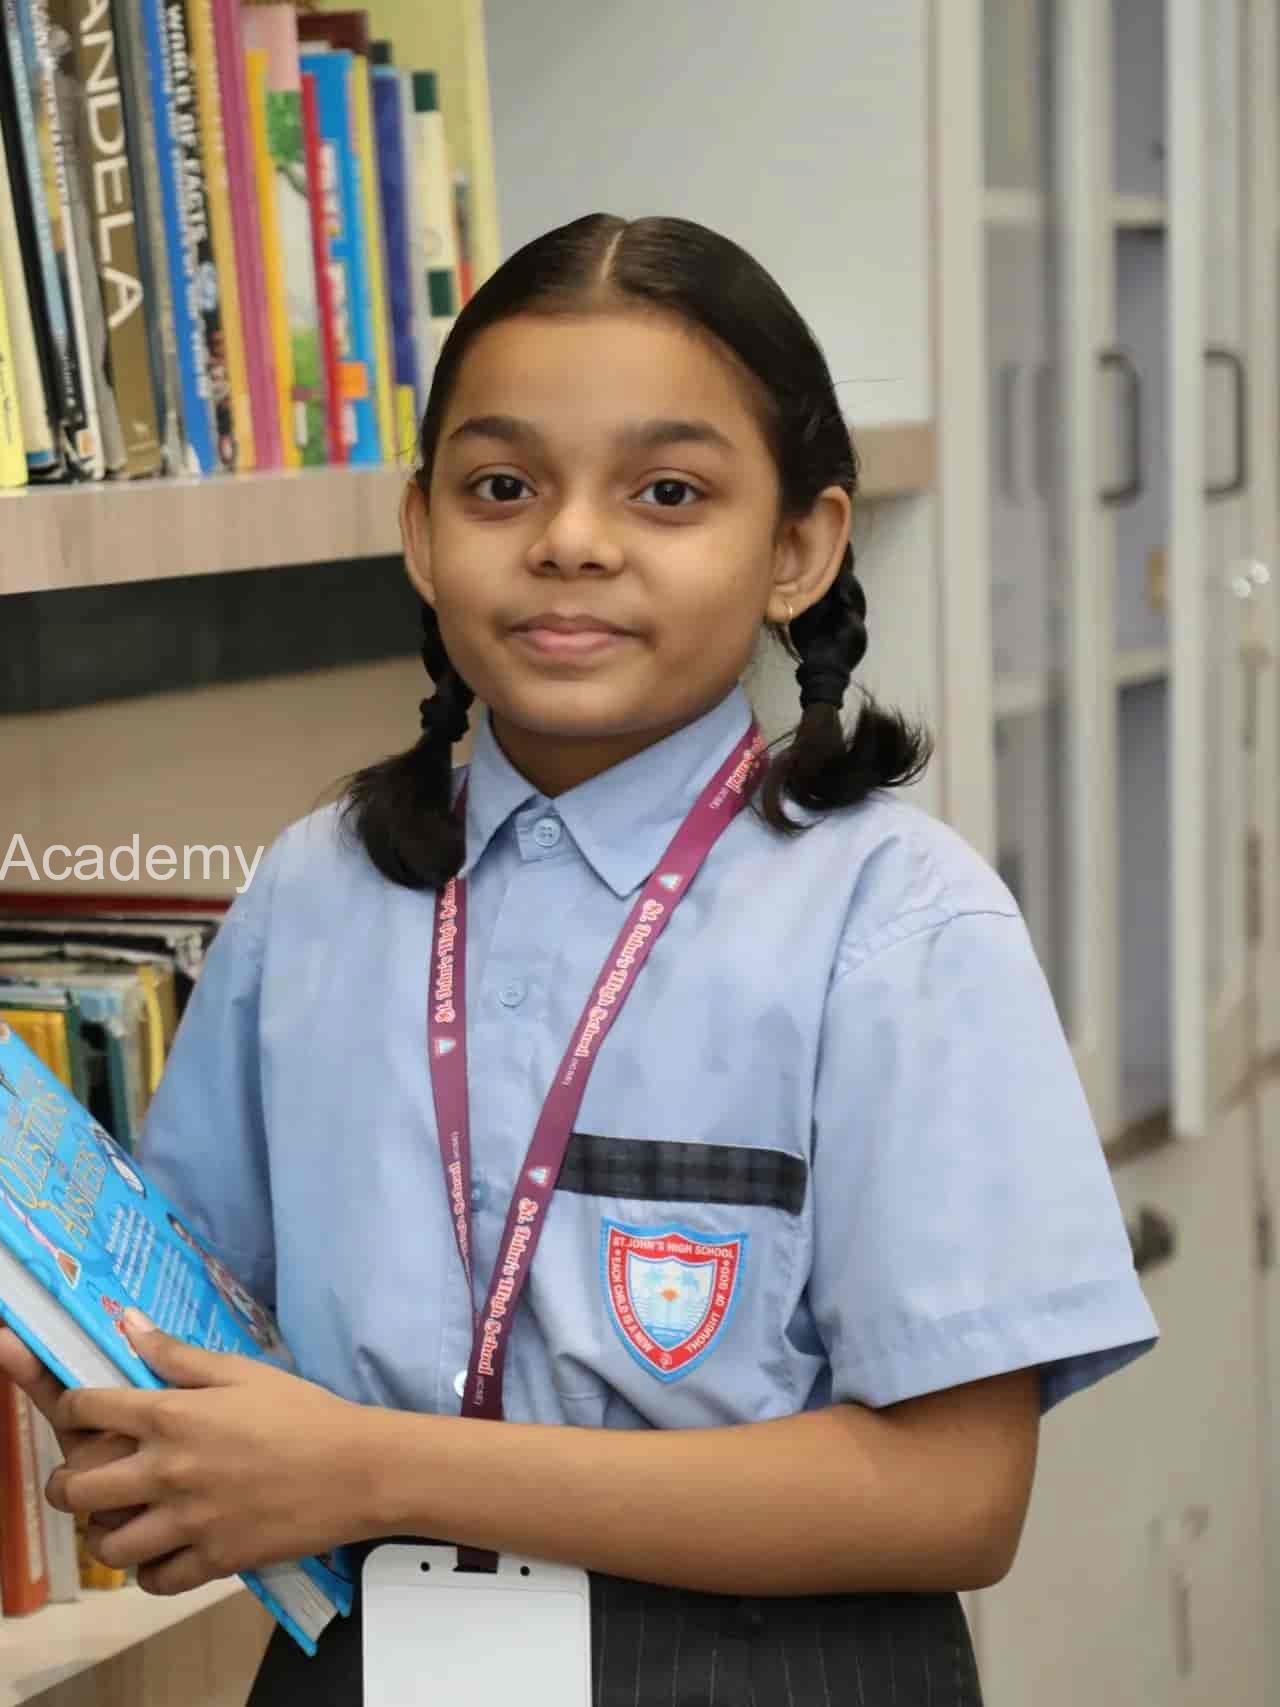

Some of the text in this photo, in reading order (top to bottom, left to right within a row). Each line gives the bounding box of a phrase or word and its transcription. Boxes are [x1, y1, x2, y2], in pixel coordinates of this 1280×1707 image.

[639, 899, 665, 924] St.
[616, 922, 653, 970] John's
[596, 967, 629, 1010] High
[574, 1005, 609, 1059] School
[518, 1196, 539, 1225] St.
[503, 1223, 532, 1277] John's
[667, 1242, 693, 1255] HIGH
[694, 1245, 735, 1259] SCHOOL
[489, 1275, 516, 1319] High
[686, 1311, 721, 1354] THOUGHT
[717, 1265, 731, 1291] GOD
[477, 1317, 504, 1377] School
